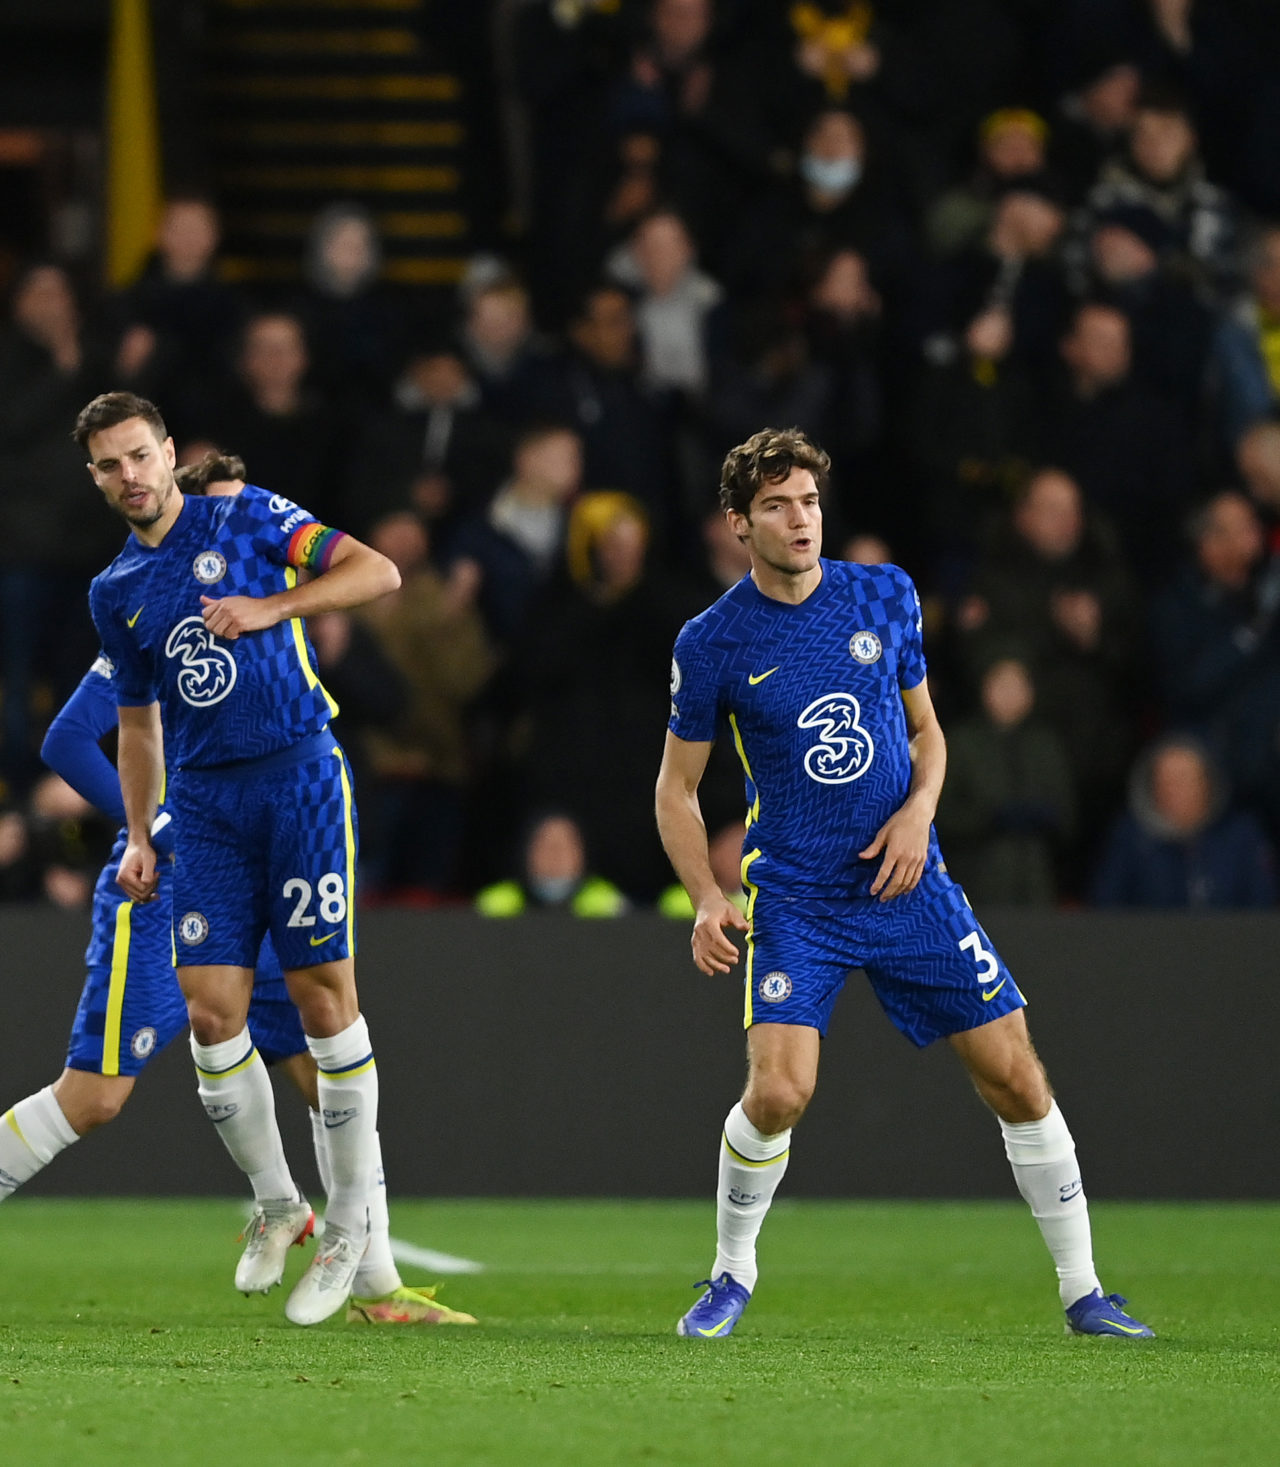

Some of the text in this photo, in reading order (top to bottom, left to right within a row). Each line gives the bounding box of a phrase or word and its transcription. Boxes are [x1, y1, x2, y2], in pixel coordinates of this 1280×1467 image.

[797, 692, 874, 785] 3
[283, 872, 346, 928] 28
[958, 931, 999, 984] 3
